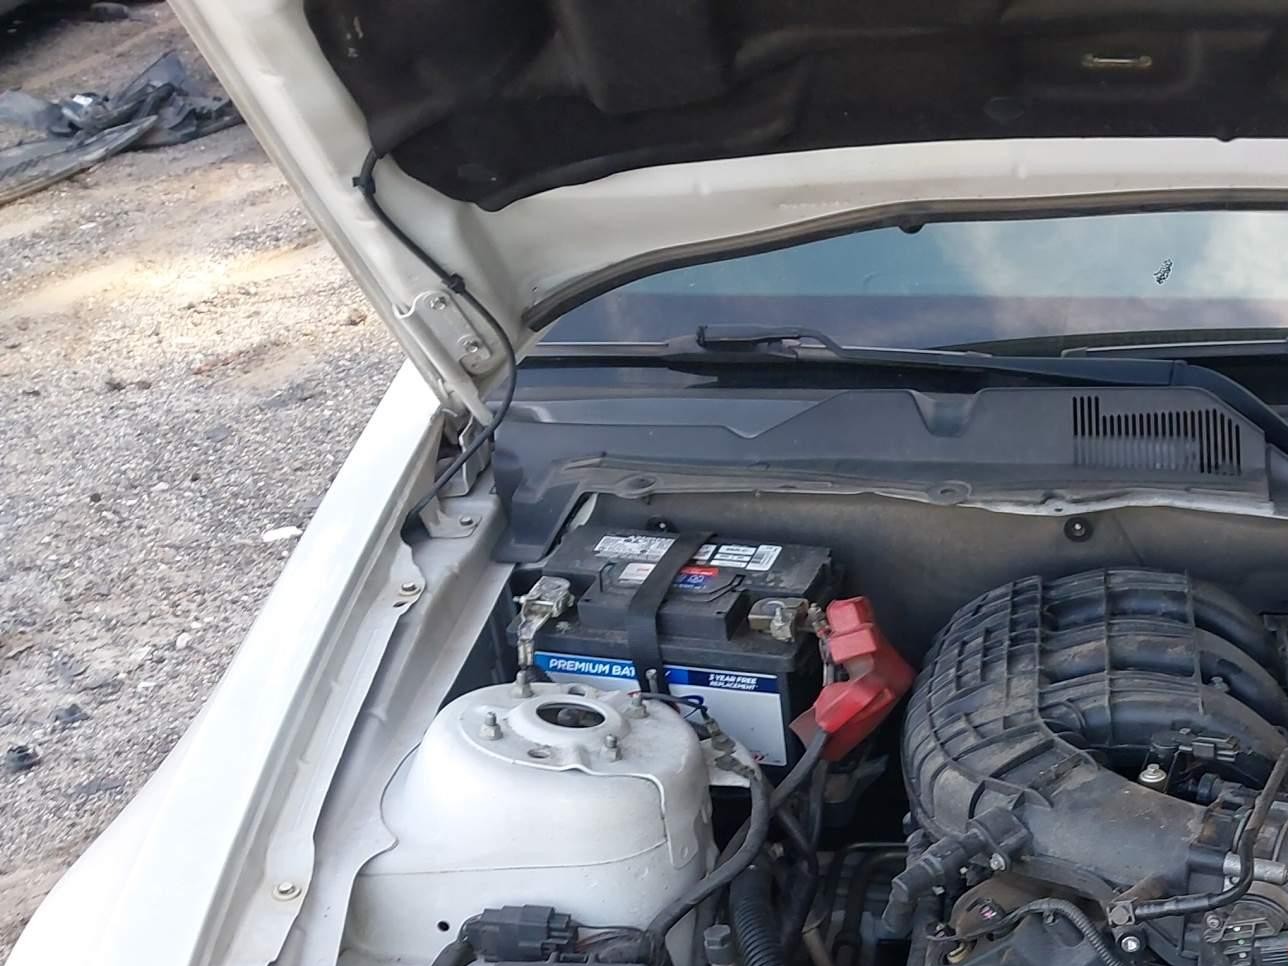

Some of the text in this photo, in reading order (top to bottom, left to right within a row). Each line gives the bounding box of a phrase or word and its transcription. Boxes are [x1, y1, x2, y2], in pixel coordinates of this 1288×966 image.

[549, 658, 610, 675] PREMIUM
[715, 674, 736, 683] YEAR
[736, 676, 758, 685] FREE
